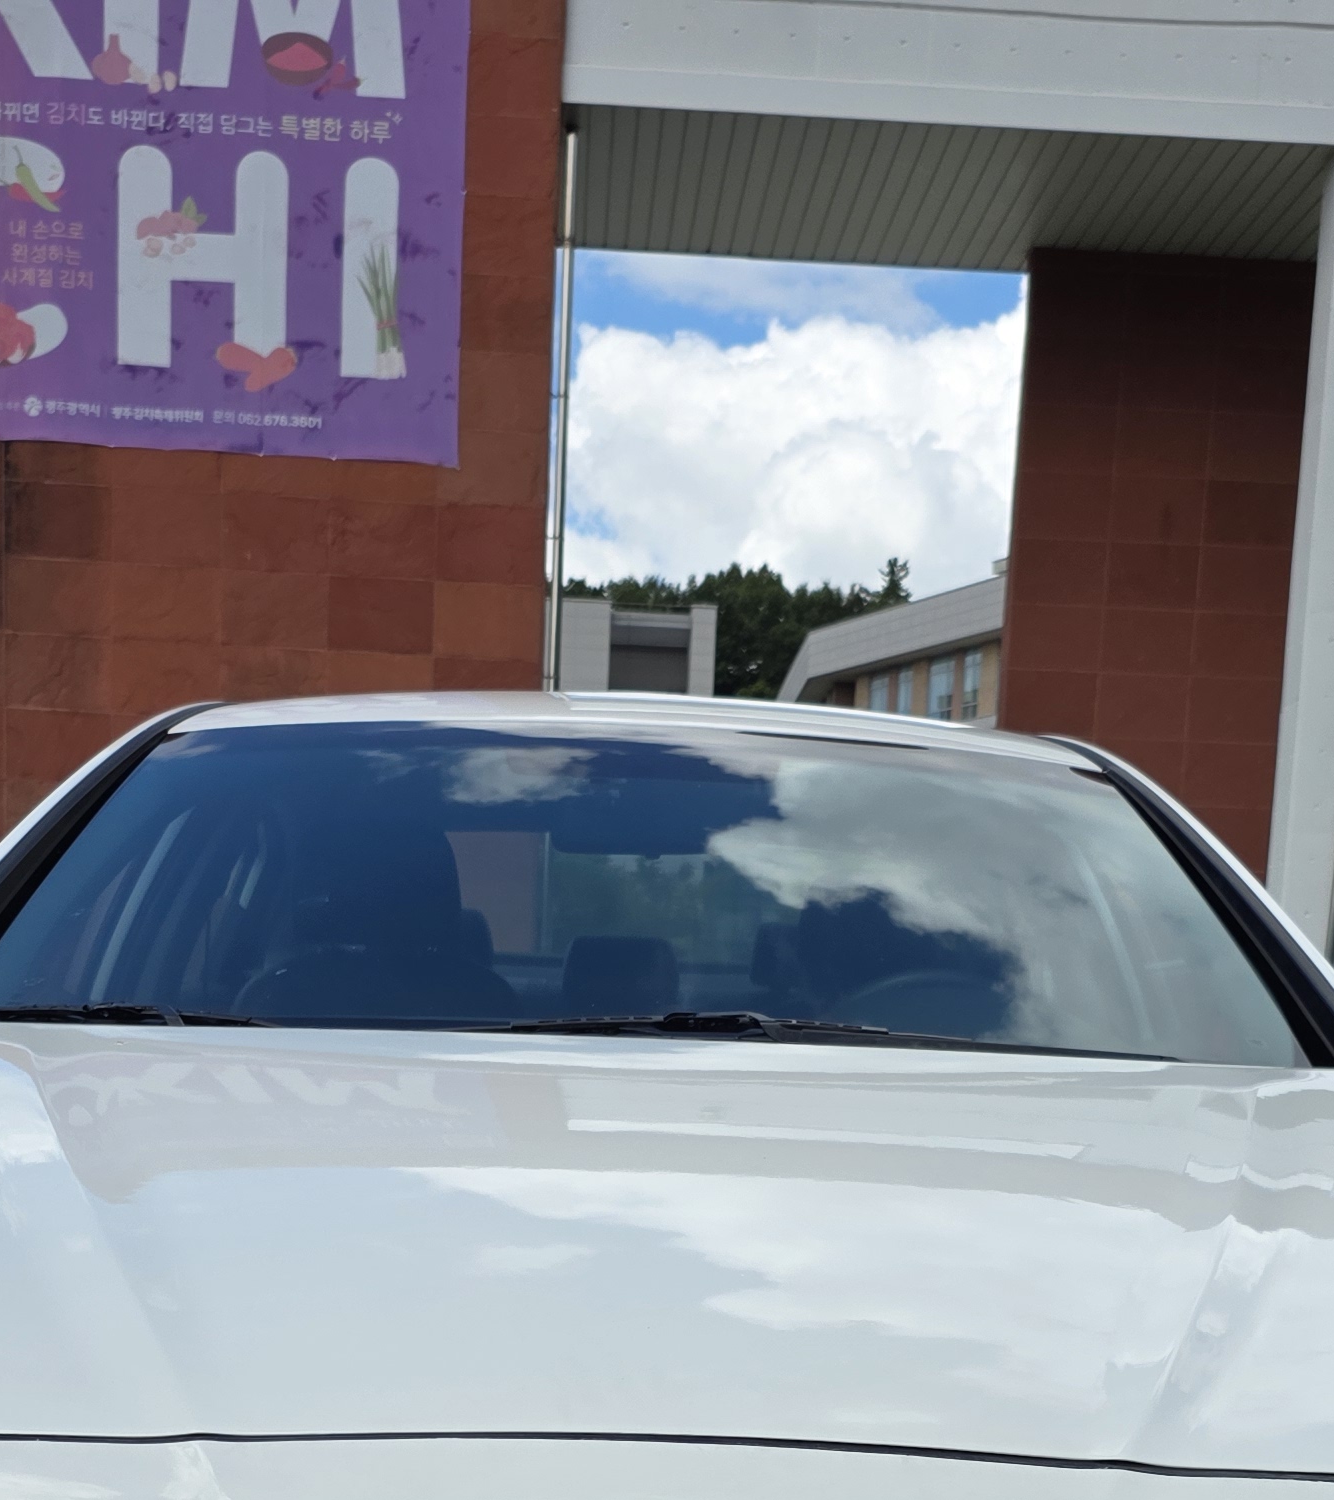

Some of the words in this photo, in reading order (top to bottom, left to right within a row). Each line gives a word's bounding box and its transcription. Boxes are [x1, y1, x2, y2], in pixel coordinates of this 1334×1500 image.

[46, 102, 105, 126] 김치도
[177, 112, 214, 134] 직접
[220, 114, 273, 137] 담그는
[278, 115, 343, 142] 특별한
[350, 119, 392, 144] 하루
[9, 219, 26, 238] 내
[31, 220, 85, 240] 손으로
[10, 243, 81, 266] 완성하는
[1, 266, 54, 288] 사계절
[59, 269, 94, 290] 김치
